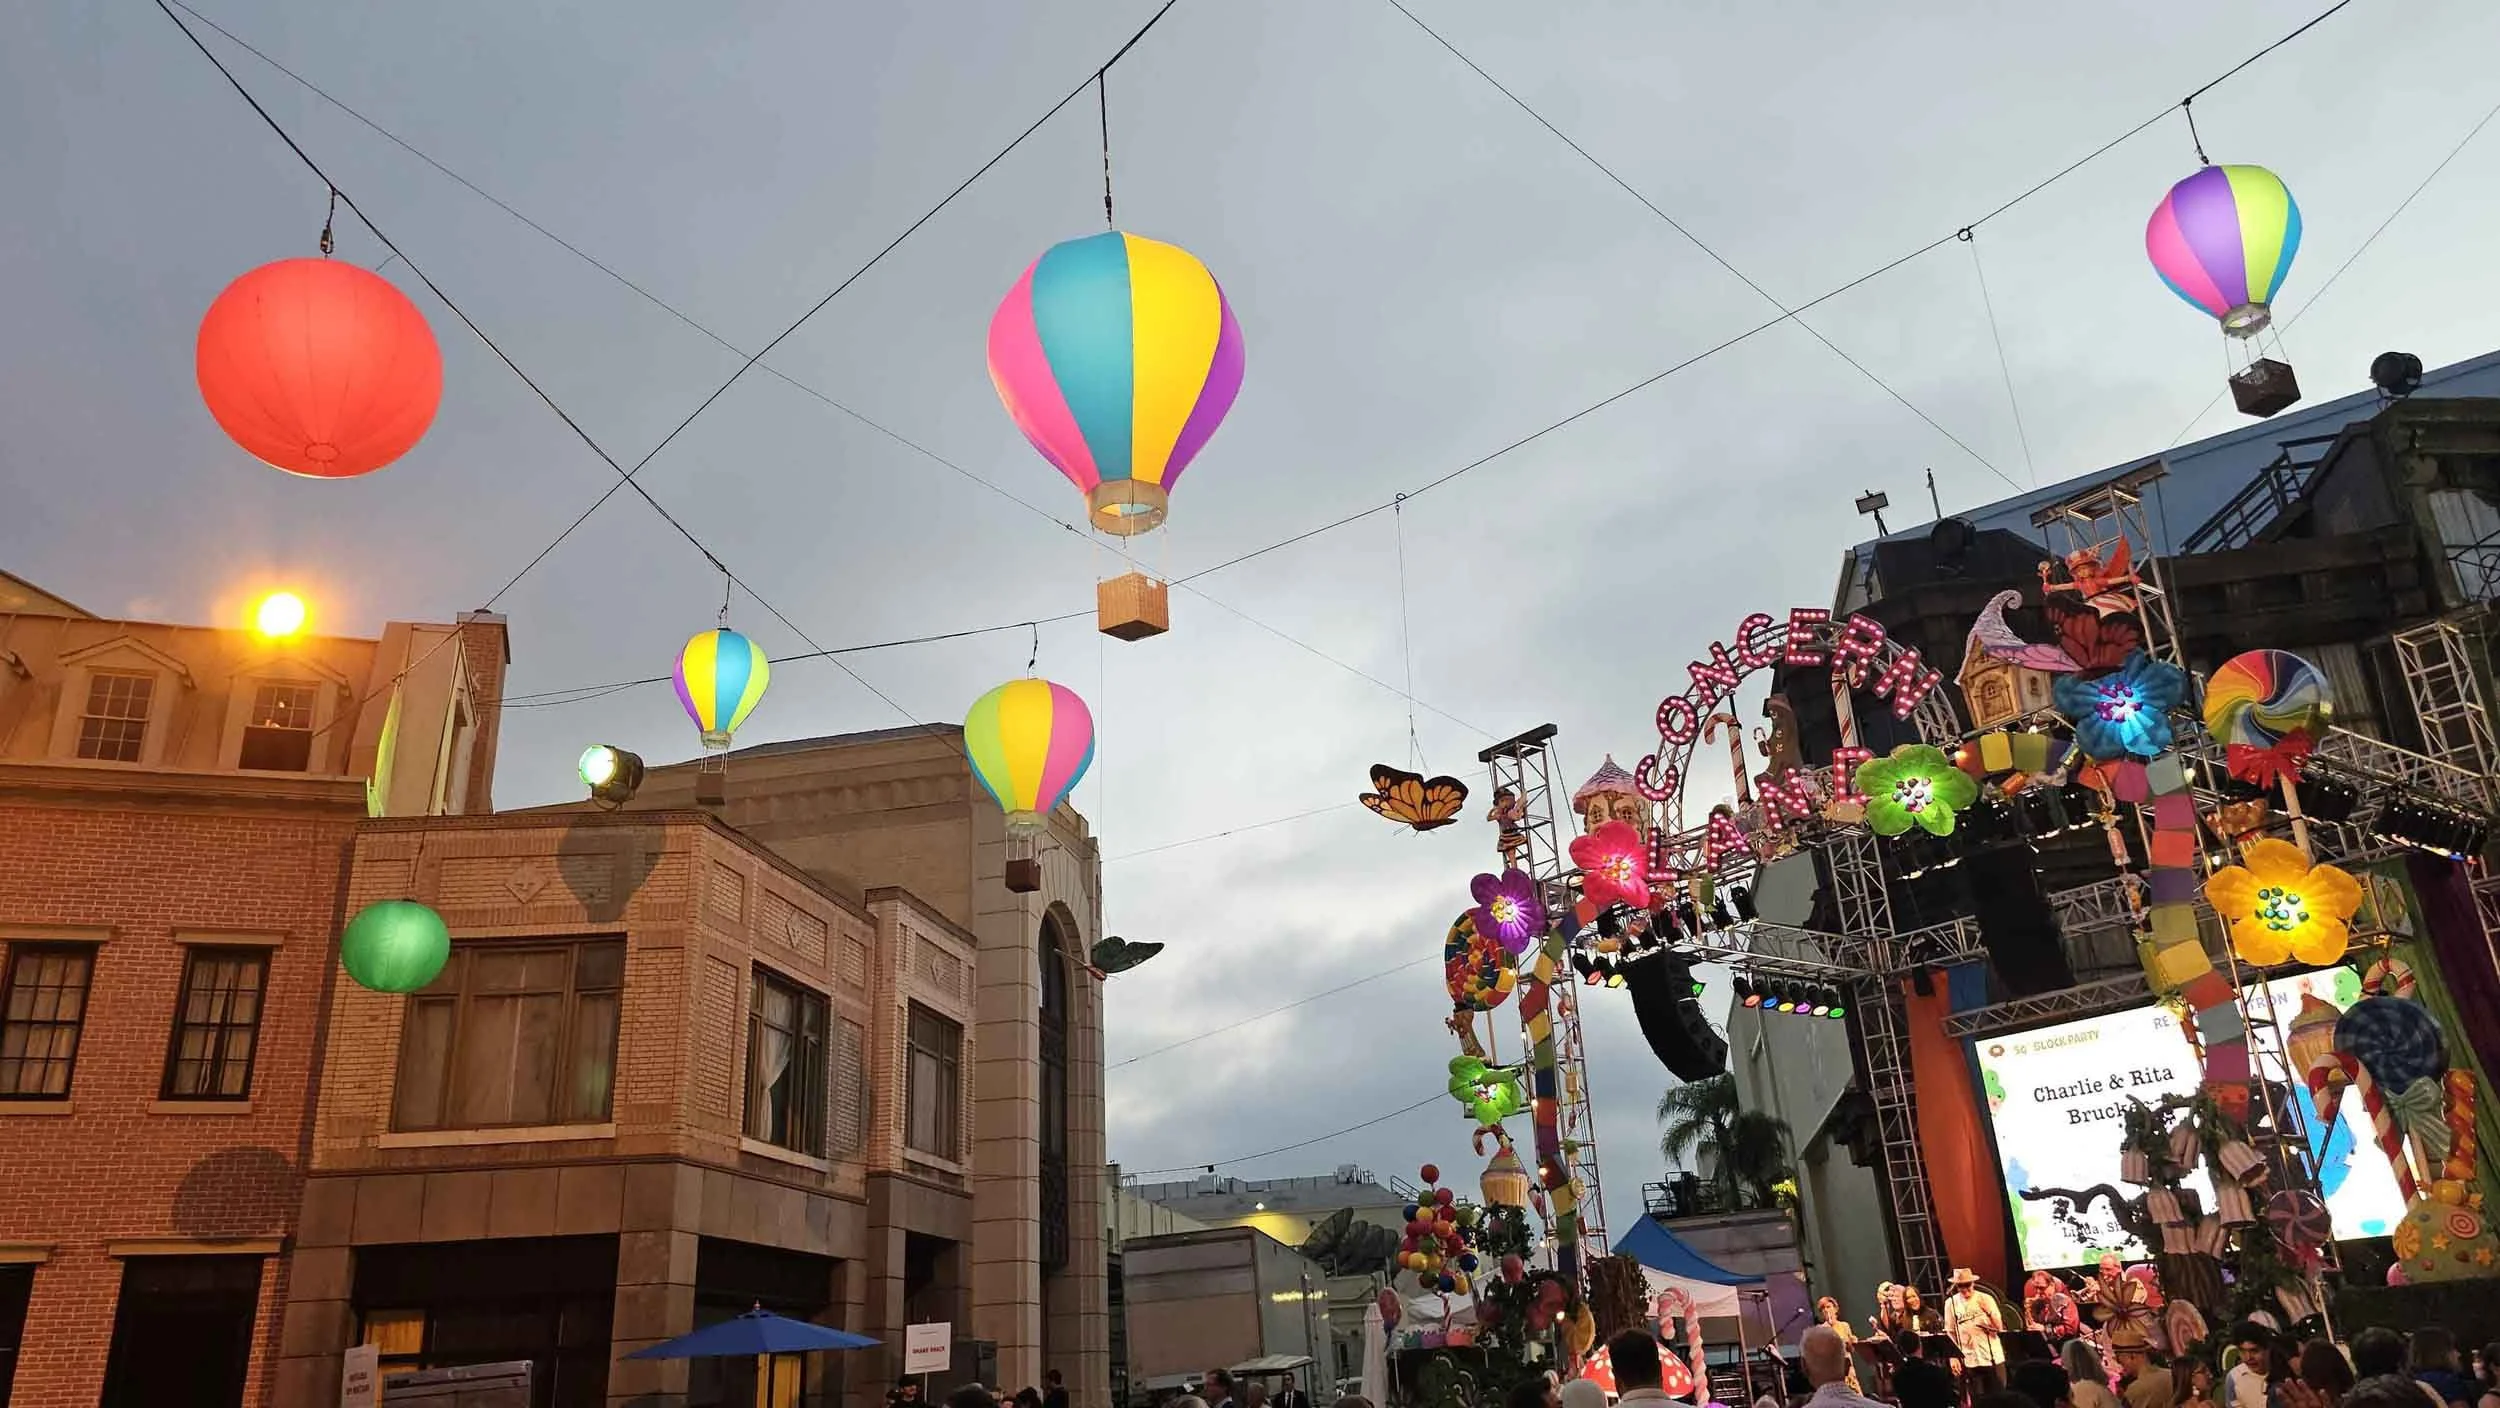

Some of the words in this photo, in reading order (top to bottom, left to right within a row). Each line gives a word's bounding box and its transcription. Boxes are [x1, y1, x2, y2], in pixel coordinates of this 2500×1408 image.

[1634, 608, 1944, 801] CONCERN
[1648, 746, 1875, 882] LAND
[2034, 1077, 2103, 1103] Charlie
[2108, 1073, 2124, 1090] &
[2128, 1067, 2175, 1087] Rita
